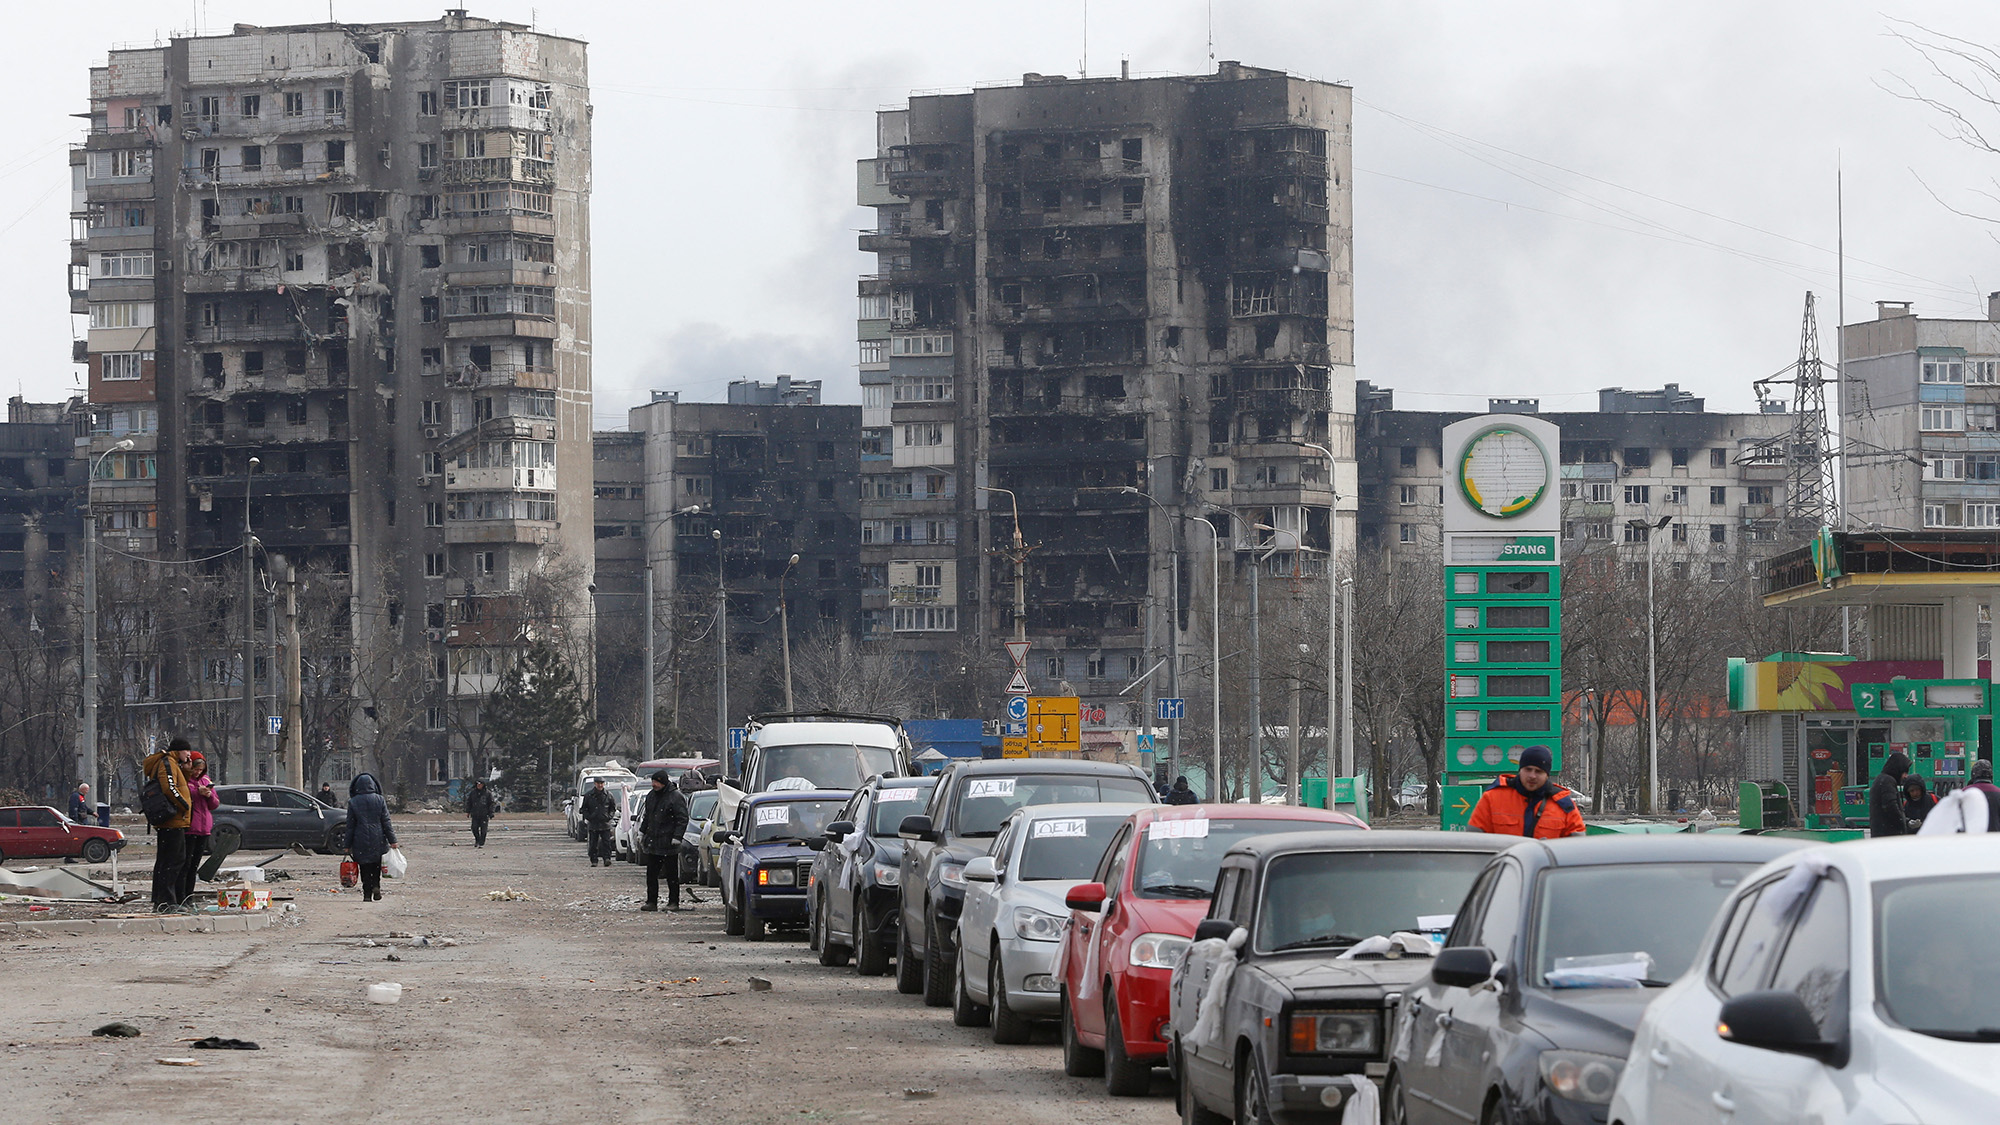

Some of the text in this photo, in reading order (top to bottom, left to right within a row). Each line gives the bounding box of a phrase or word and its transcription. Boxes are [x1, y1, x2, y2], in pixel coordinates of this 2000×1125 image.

[1500, 545, 1546, 555] STANG
[1863, 693, 1875, 709] 2
[1905, 690, 1918, 706] 4
[880, 790, 917, 801] ДЕТИ
[971, 781, 1013, 796] ДЕТИ
[758, 809, 788, 822] ДЕТИ
[1036, 822, 1084, 836] ДЕТИ
